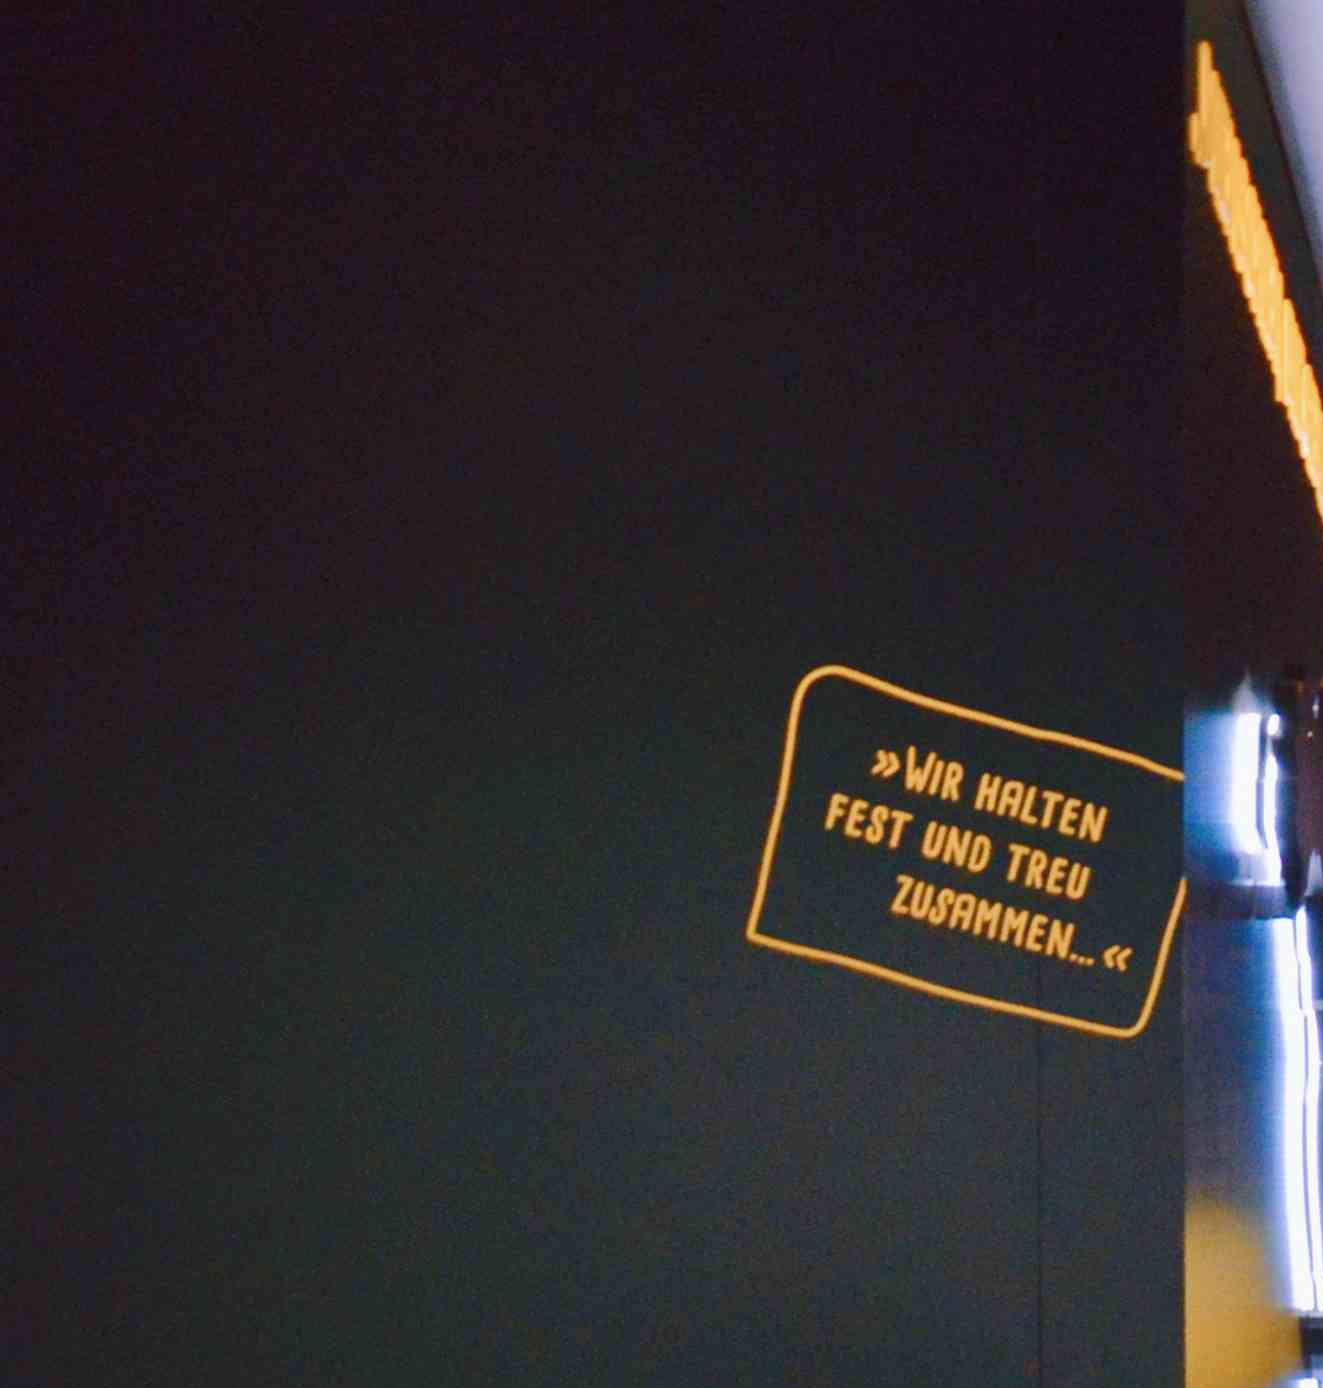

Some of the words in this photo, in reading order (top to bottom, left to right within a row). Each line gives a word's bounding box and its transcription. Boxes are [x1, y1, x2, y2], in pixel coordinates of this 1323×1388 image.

[825, 793, 913, 849] FEST
[922, 820, 992, 873] UND
[1007, 844, 1091, 900] TREU
[975, 773, 1109, 842] HALTEN
